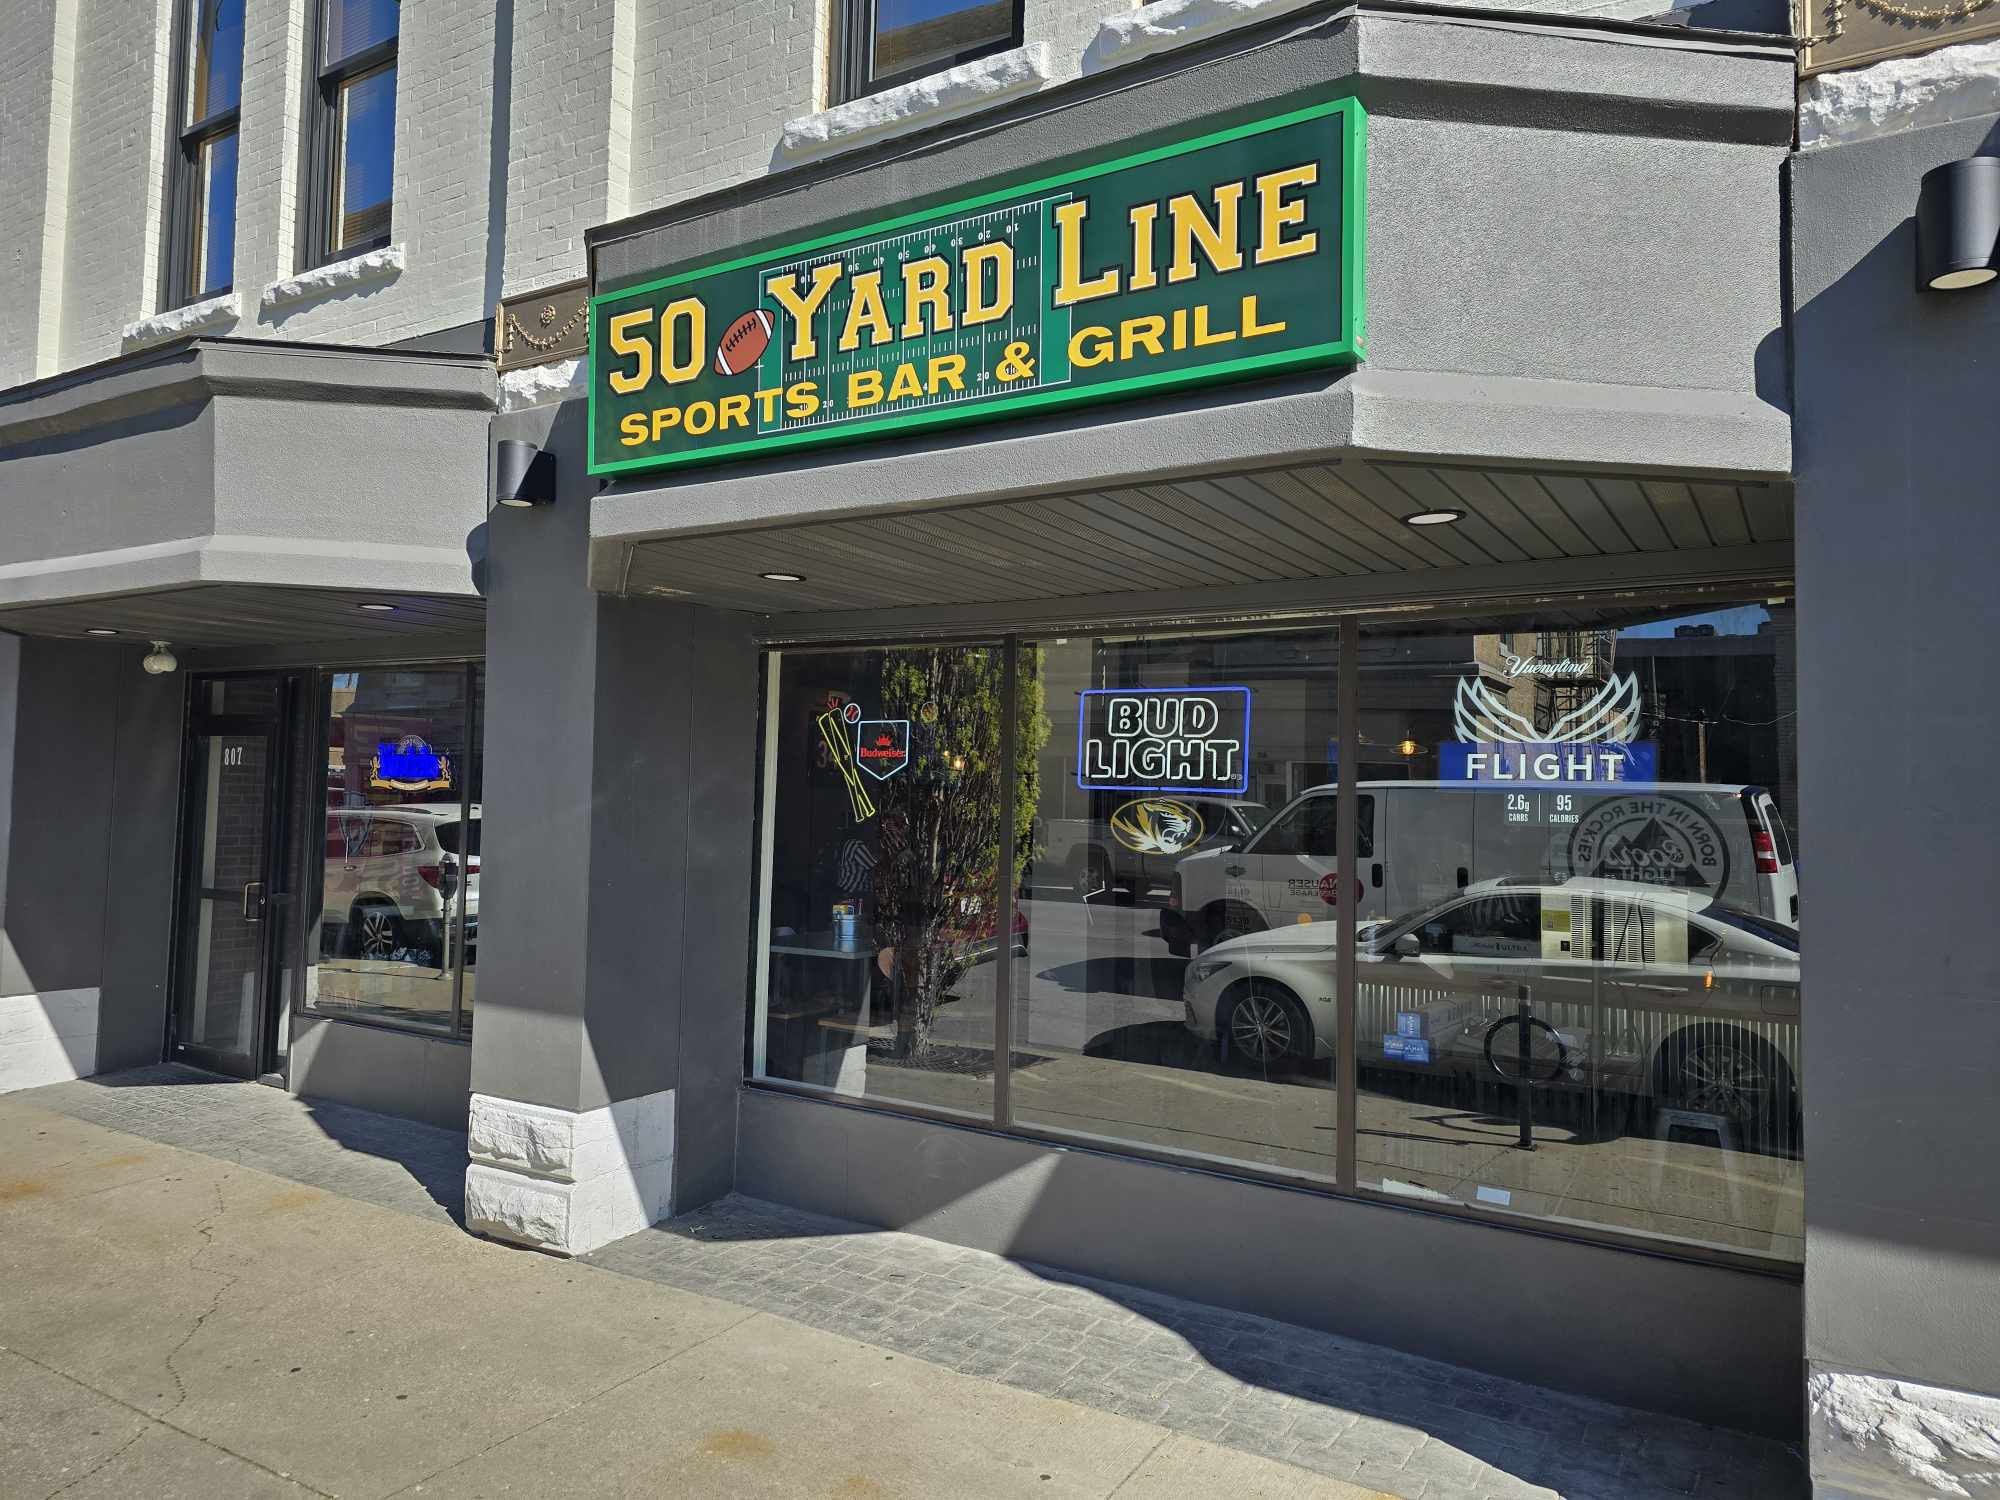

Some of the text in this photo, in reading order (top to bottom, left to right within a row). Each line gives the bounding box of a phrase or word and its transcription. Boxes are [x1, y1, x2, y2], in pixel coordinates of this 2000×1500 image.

[607, 162, 1318, 396] 50 YARD LINE
[619, 295, 1287, 447] SPORTS BAR & GRILL
[1503, 655, 1593, 679] Yuengling
[1108, 697, 1219, 738] BUD
[224, 746, 243, 766] 807
[860, 747, 905, 759] Budweiser
[1086, 738, 1240, 781] LIGHT
[1465, 753, 1625, 782] FLIGHT
[1507, 793, 1572, 813] 2.6g 95
[1508, 813, 1580, 824] CARBS CALORIES
